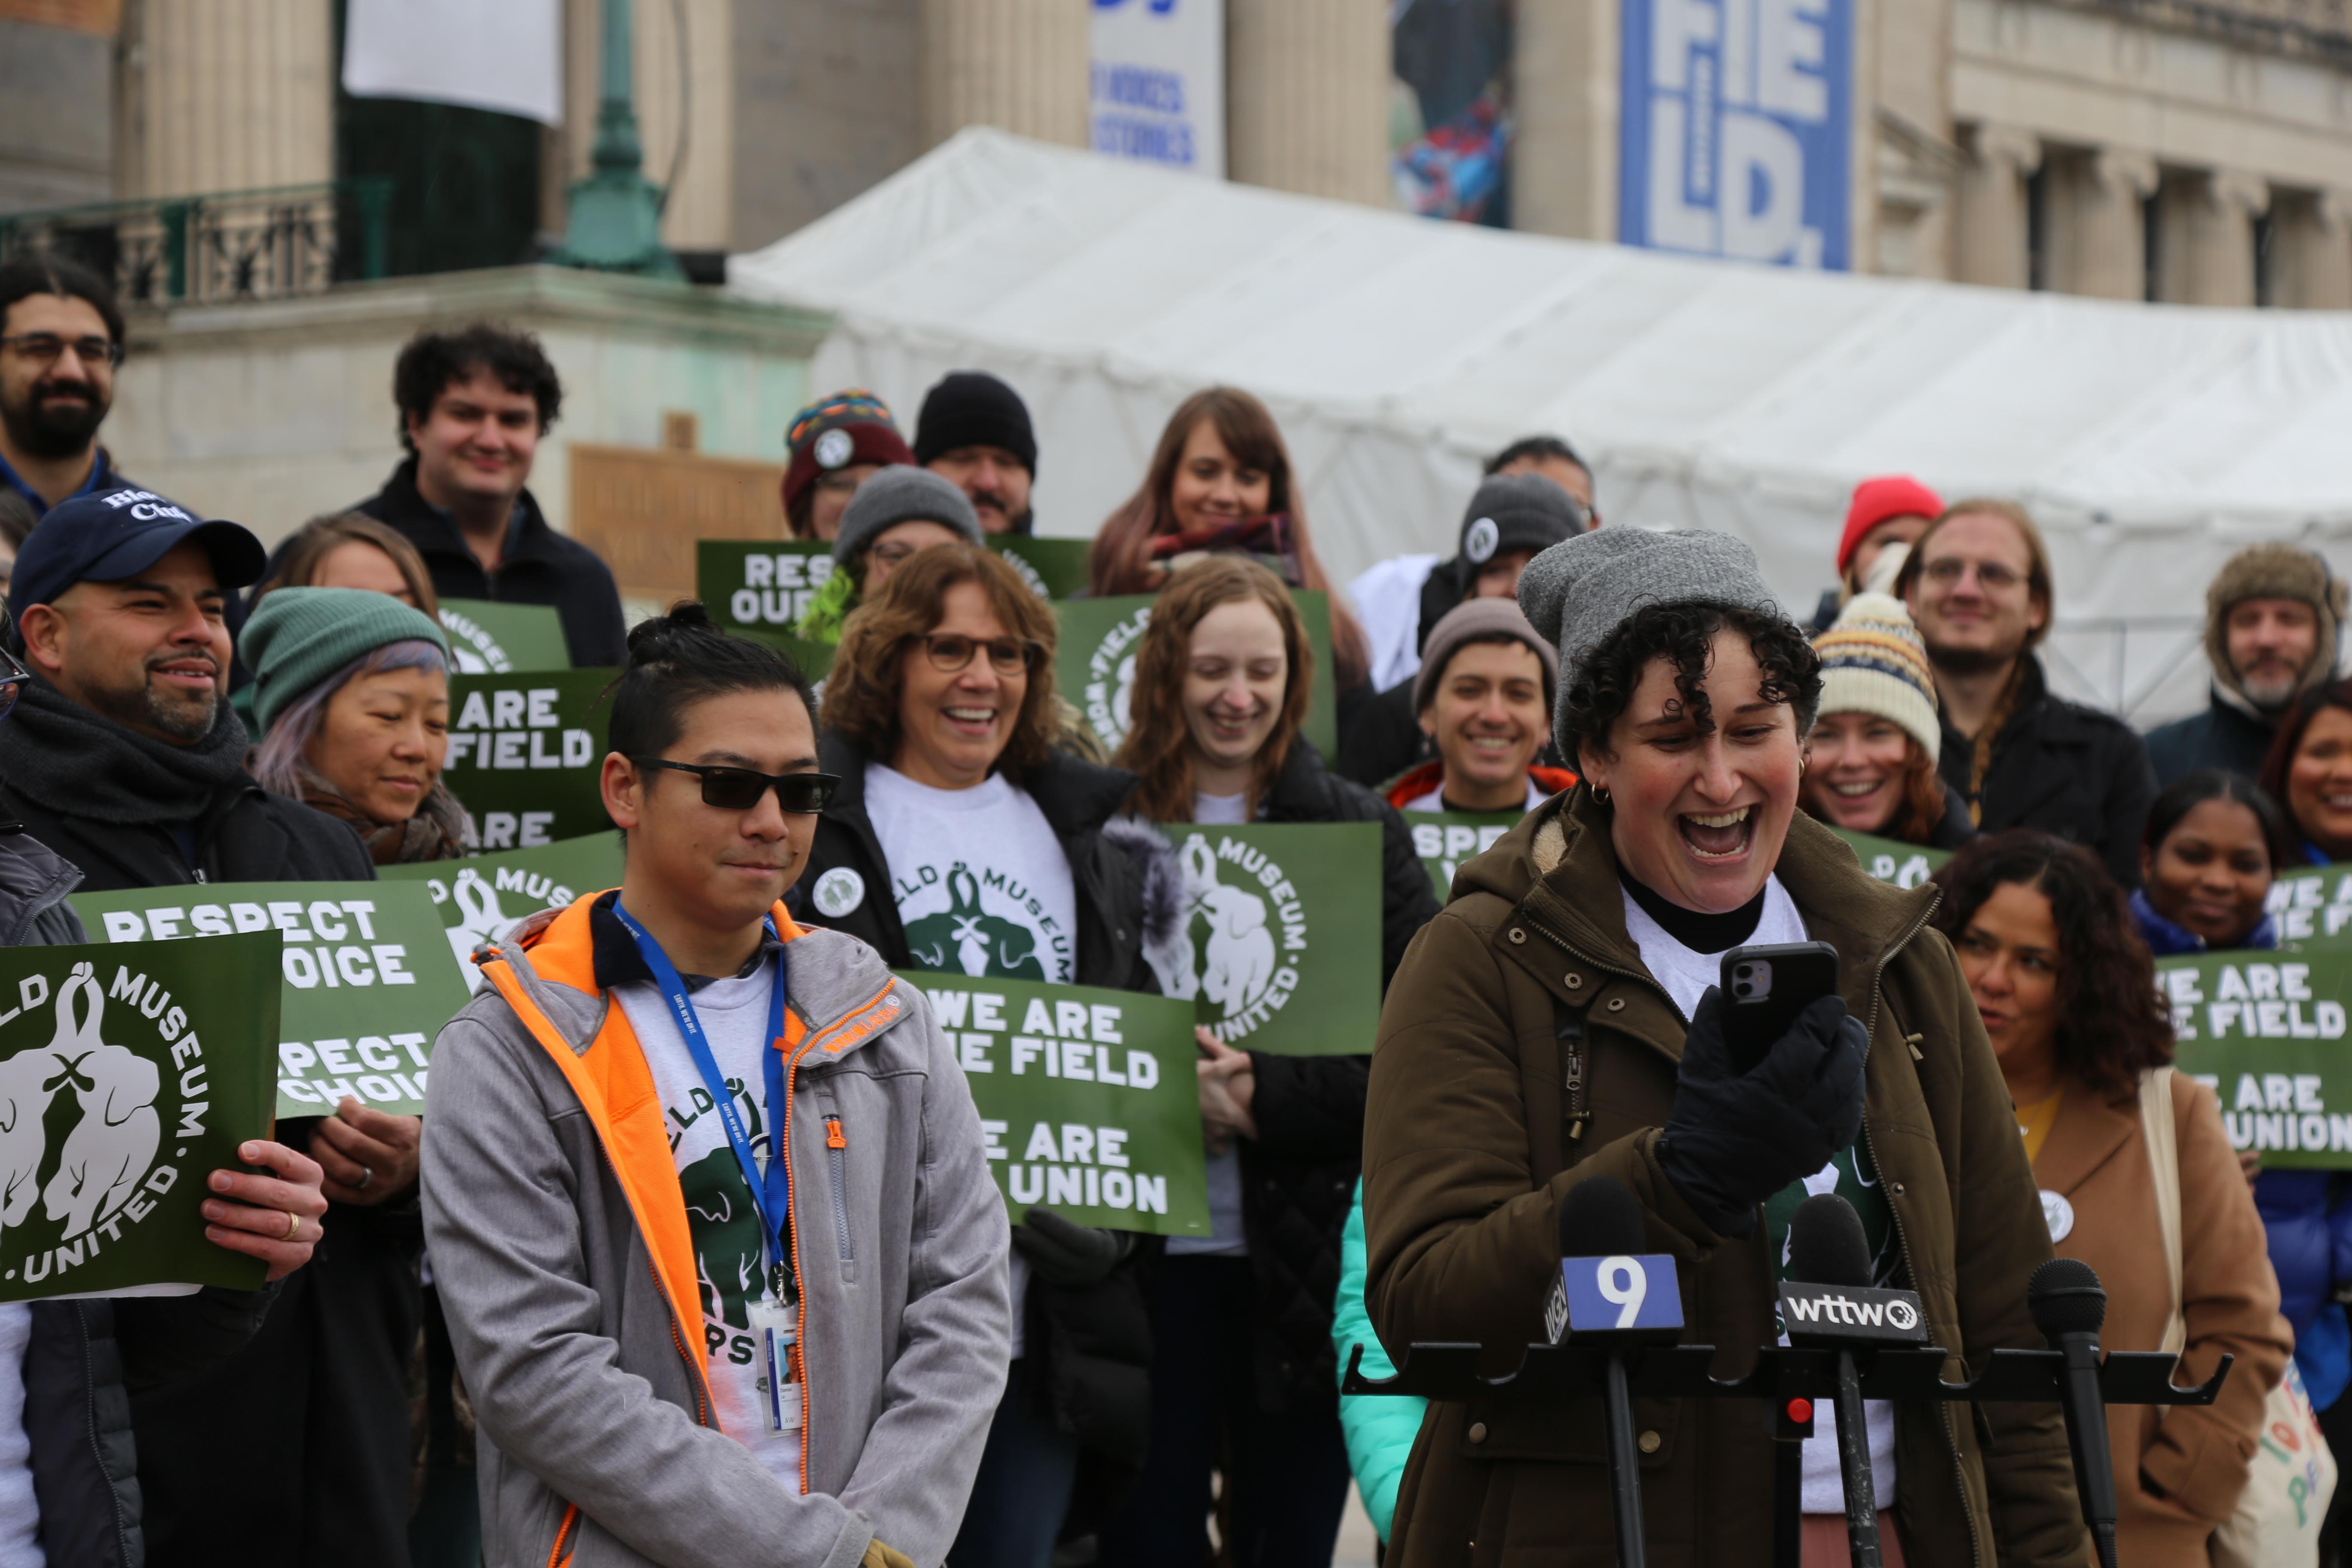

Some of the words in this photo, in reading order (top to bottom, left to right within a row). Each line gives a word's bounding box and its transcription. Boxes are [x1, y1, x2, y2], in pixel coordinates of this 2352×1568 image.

[456, 689, 560, 729] ARE
[442, 729, 595, 771] FIELD
[1217, 836, 1308, 950] MUSEUM
[102, 900, 377, 943] RESPECT
[983, 867, 1074, 983] MUSEUM
[283, 944, 416, 989] OICE
[2217, 962, 2312, 1001] ARE
[926, 989, 1007, 1032] WE
[1022, 997, 1123, 1045] ARE
[2207, 1000, 2347, 1040] FIELD
[108, 965, 211, 1138] MUSEUM
[277, 1032, 429, 1078] PECT
[1011, 1035, 1160, 1090] FIELD
[2235, 1073, 2324, 1112] ARE
[1024, 1121, 1130, 1168] ARE
[2224, 1112, 2352, 1152] UNION
[1008, 1163, 1167, 1215] UNION
[23, 1164, 179, 1283] UNITED
[1545, 1275, 1567, 1341] WGN
[1597, 1256, 1647, 1329] 9
[1786, 1293, 1884, 1327] wttw
